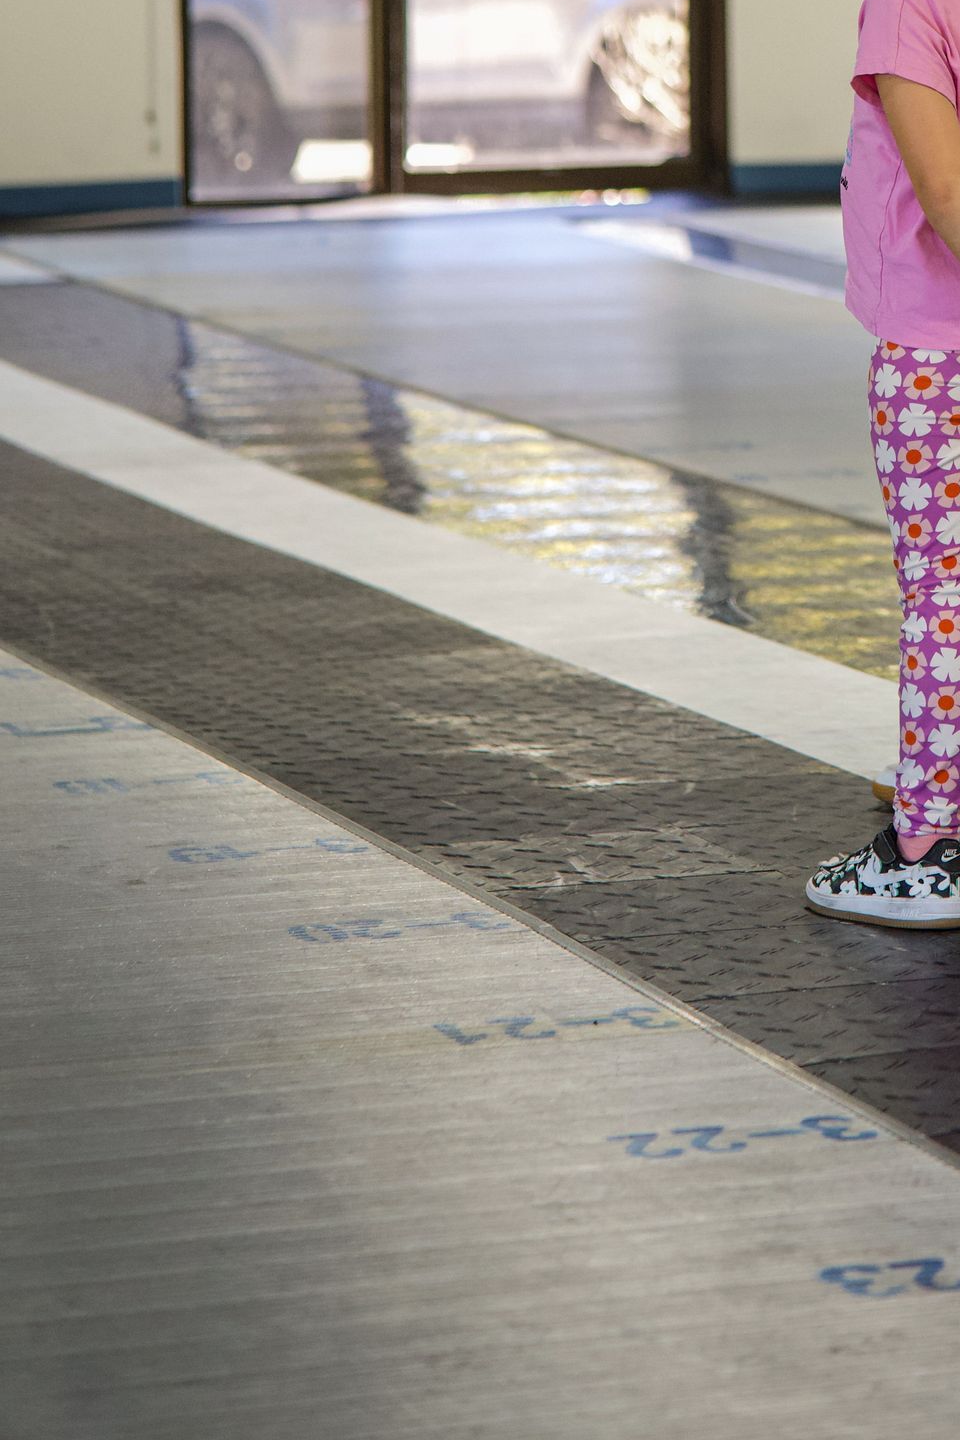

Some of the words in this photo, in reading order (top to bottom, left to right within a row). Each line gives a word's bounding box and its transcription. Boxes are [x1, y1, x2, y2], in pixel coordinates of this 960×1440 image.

[944, 848, 958, 857] NIKE
[432, 1005, 681, 1046] 3-21
[607, 1114, 881, 1159] 3-22
